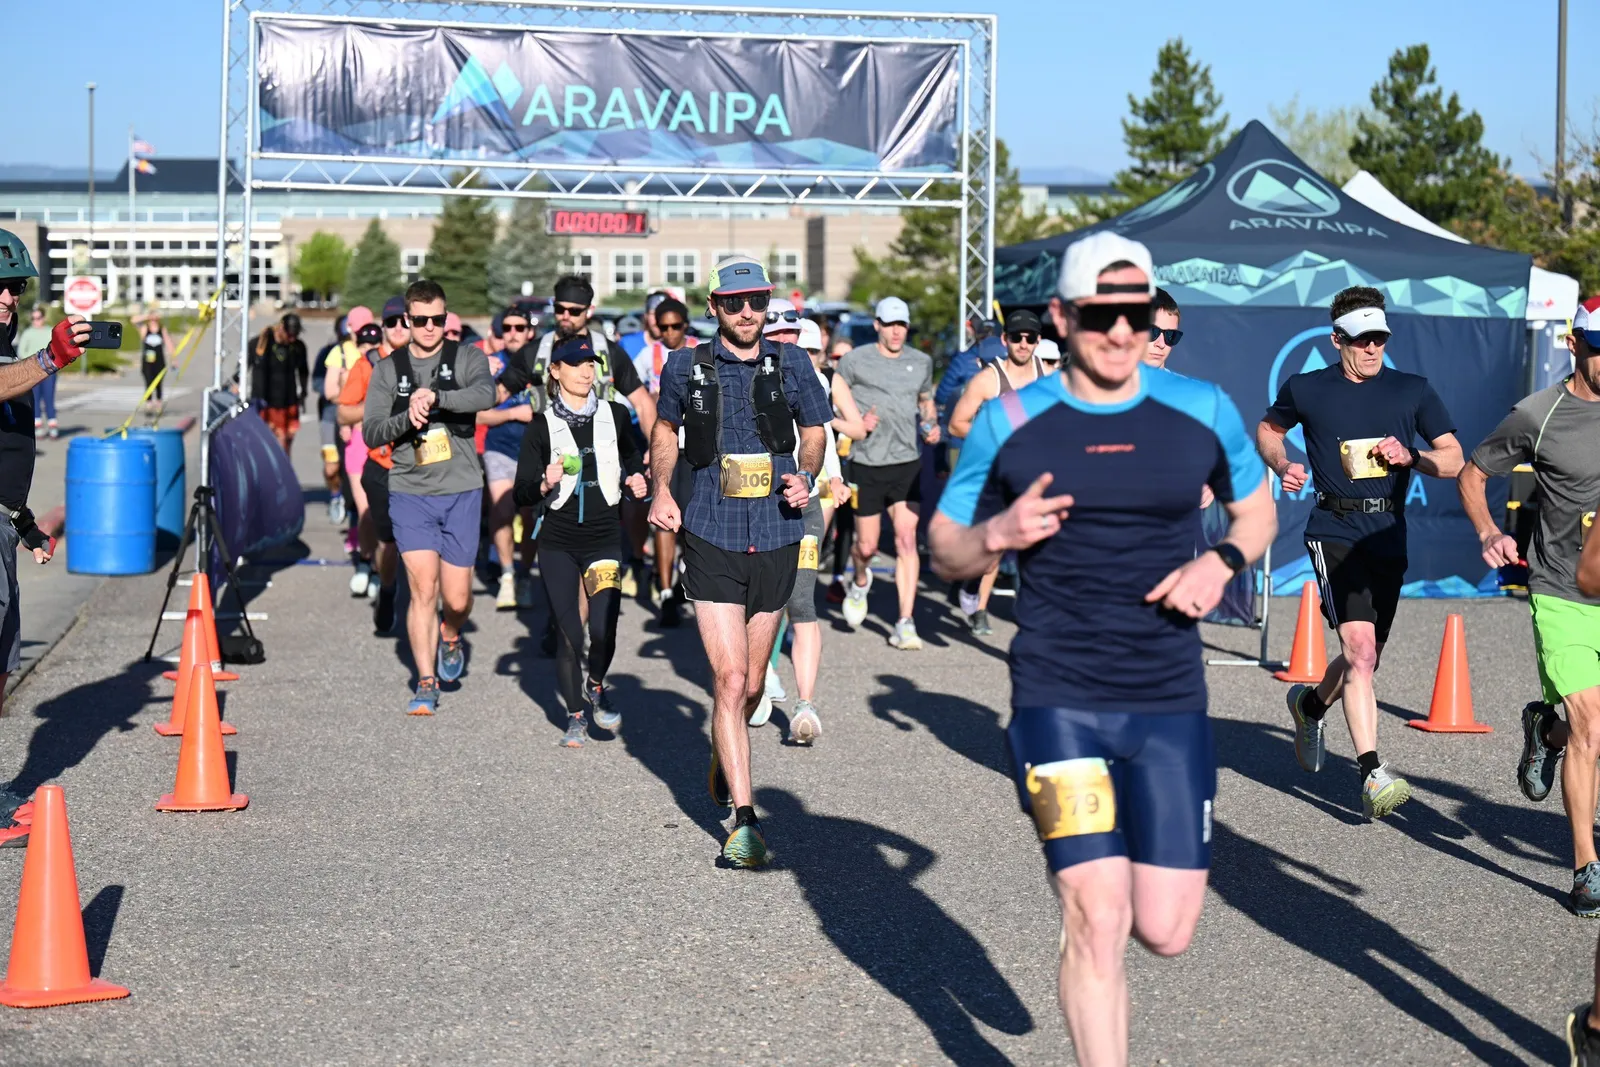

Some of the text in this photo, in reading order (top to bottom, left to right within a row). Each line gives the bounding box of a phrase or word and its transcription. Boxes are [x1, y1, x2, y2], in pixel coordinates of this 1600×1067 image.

[522, 83, 792, 136] ARAVAIPA
[1229, 217, 1389, 239] ARAVAIPA
[741, 473, 770, 488] 106
[801, 550, 815, 561] 78
[1066, 793, 1100, 816] 79
